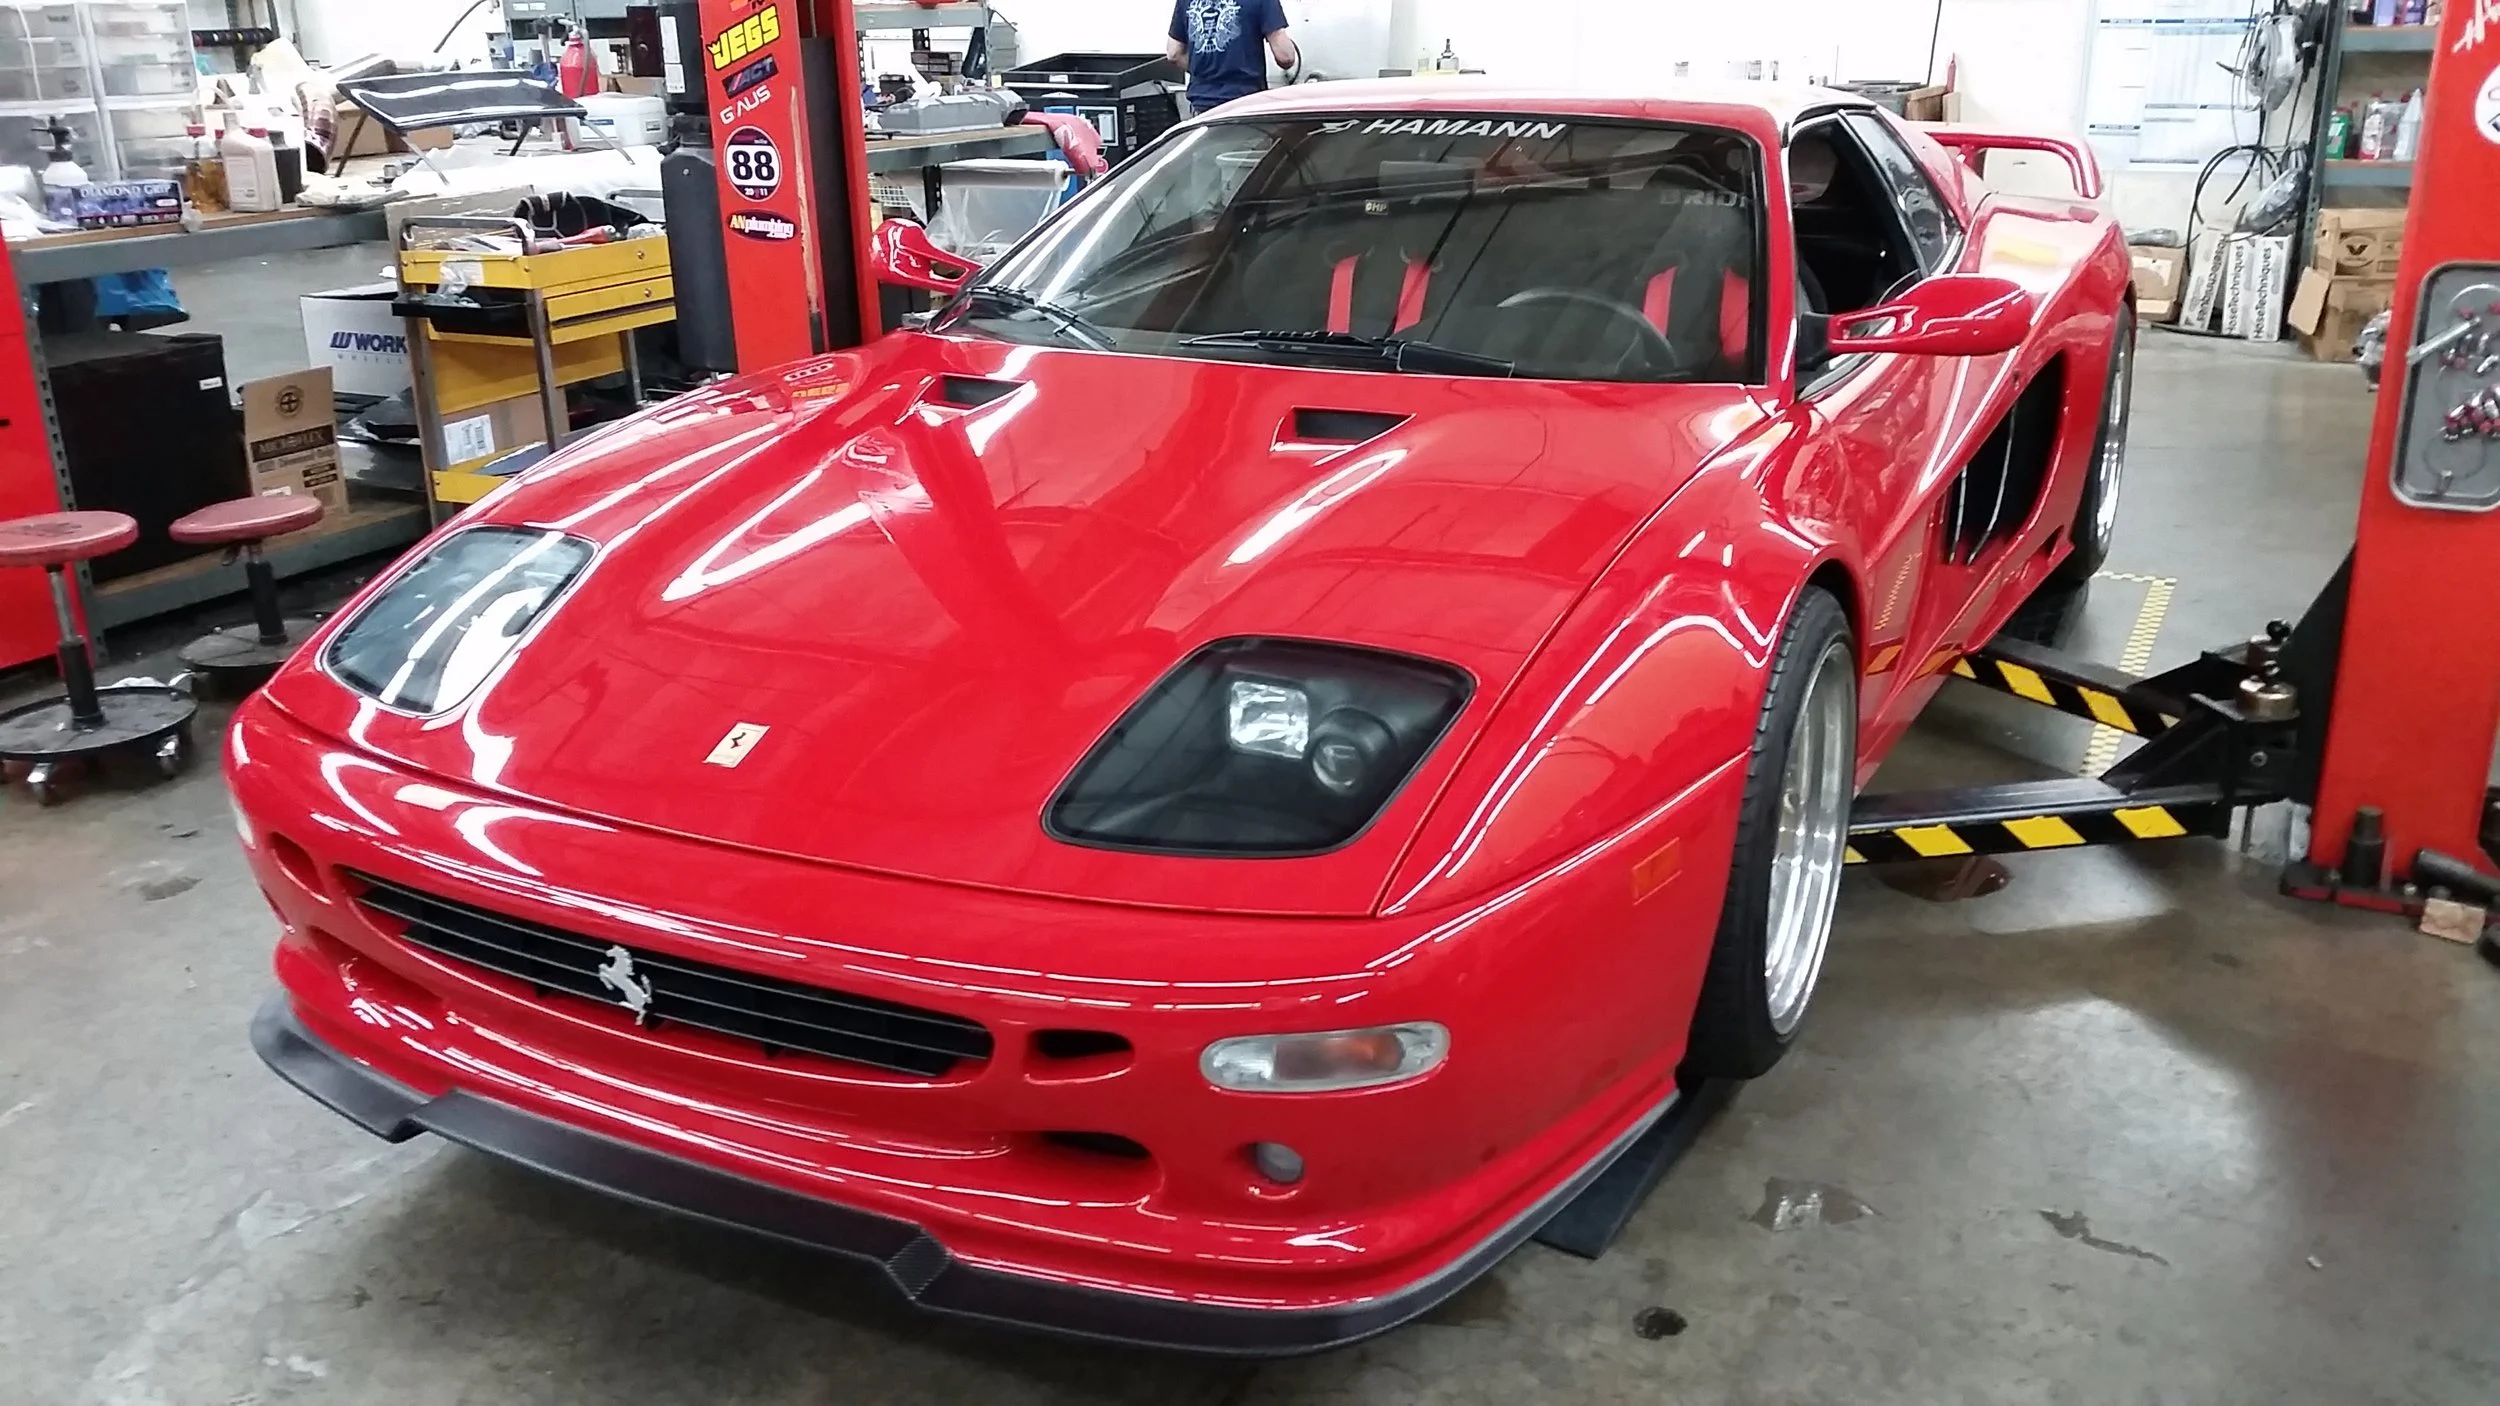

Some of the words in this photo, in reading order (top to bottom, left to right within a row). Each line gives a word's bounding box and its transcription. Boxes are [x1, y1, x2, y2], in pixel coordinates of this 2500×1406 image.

[706, 4, 780, 70] JEGS
[1361, 118, 1566, 139] HAMANN
[732, 150, 775, 181] 88
[81, 184, 142, 198] DIAMOND
[2254, 247, 2271, 338] HoseTechniques
[355, 333, 407, 354] WORK
